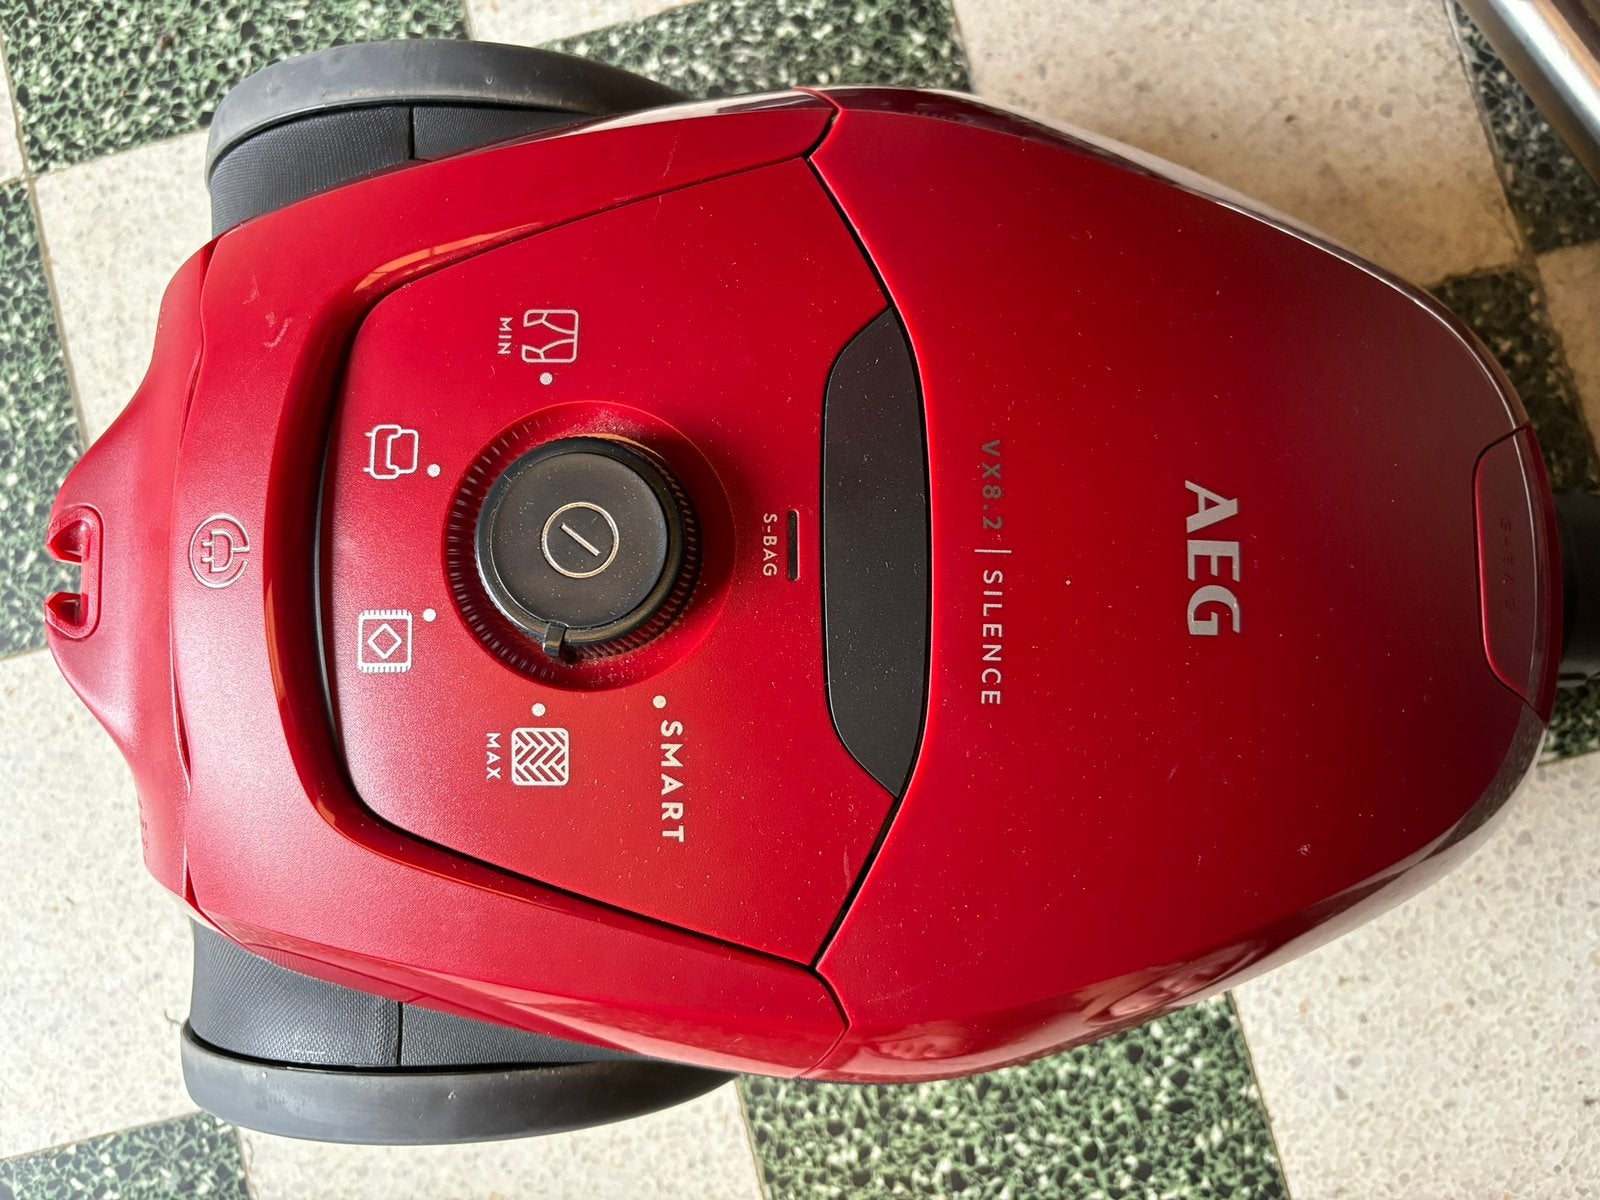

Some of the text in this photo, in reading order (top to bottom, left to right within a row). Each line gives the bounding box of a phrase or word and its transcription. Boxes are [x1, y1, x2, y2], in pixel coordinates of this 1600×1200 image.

[497, 316, 512, 356] MIN
[762, 513, 778, 577] S-BAG
[980, 439, 1004, 706] VX8.2 SILENCE
[1184, 480, 1240, 636] AEG
[485, 732, 503, 780] MAX
[660, 719, 685, 843] SMART
